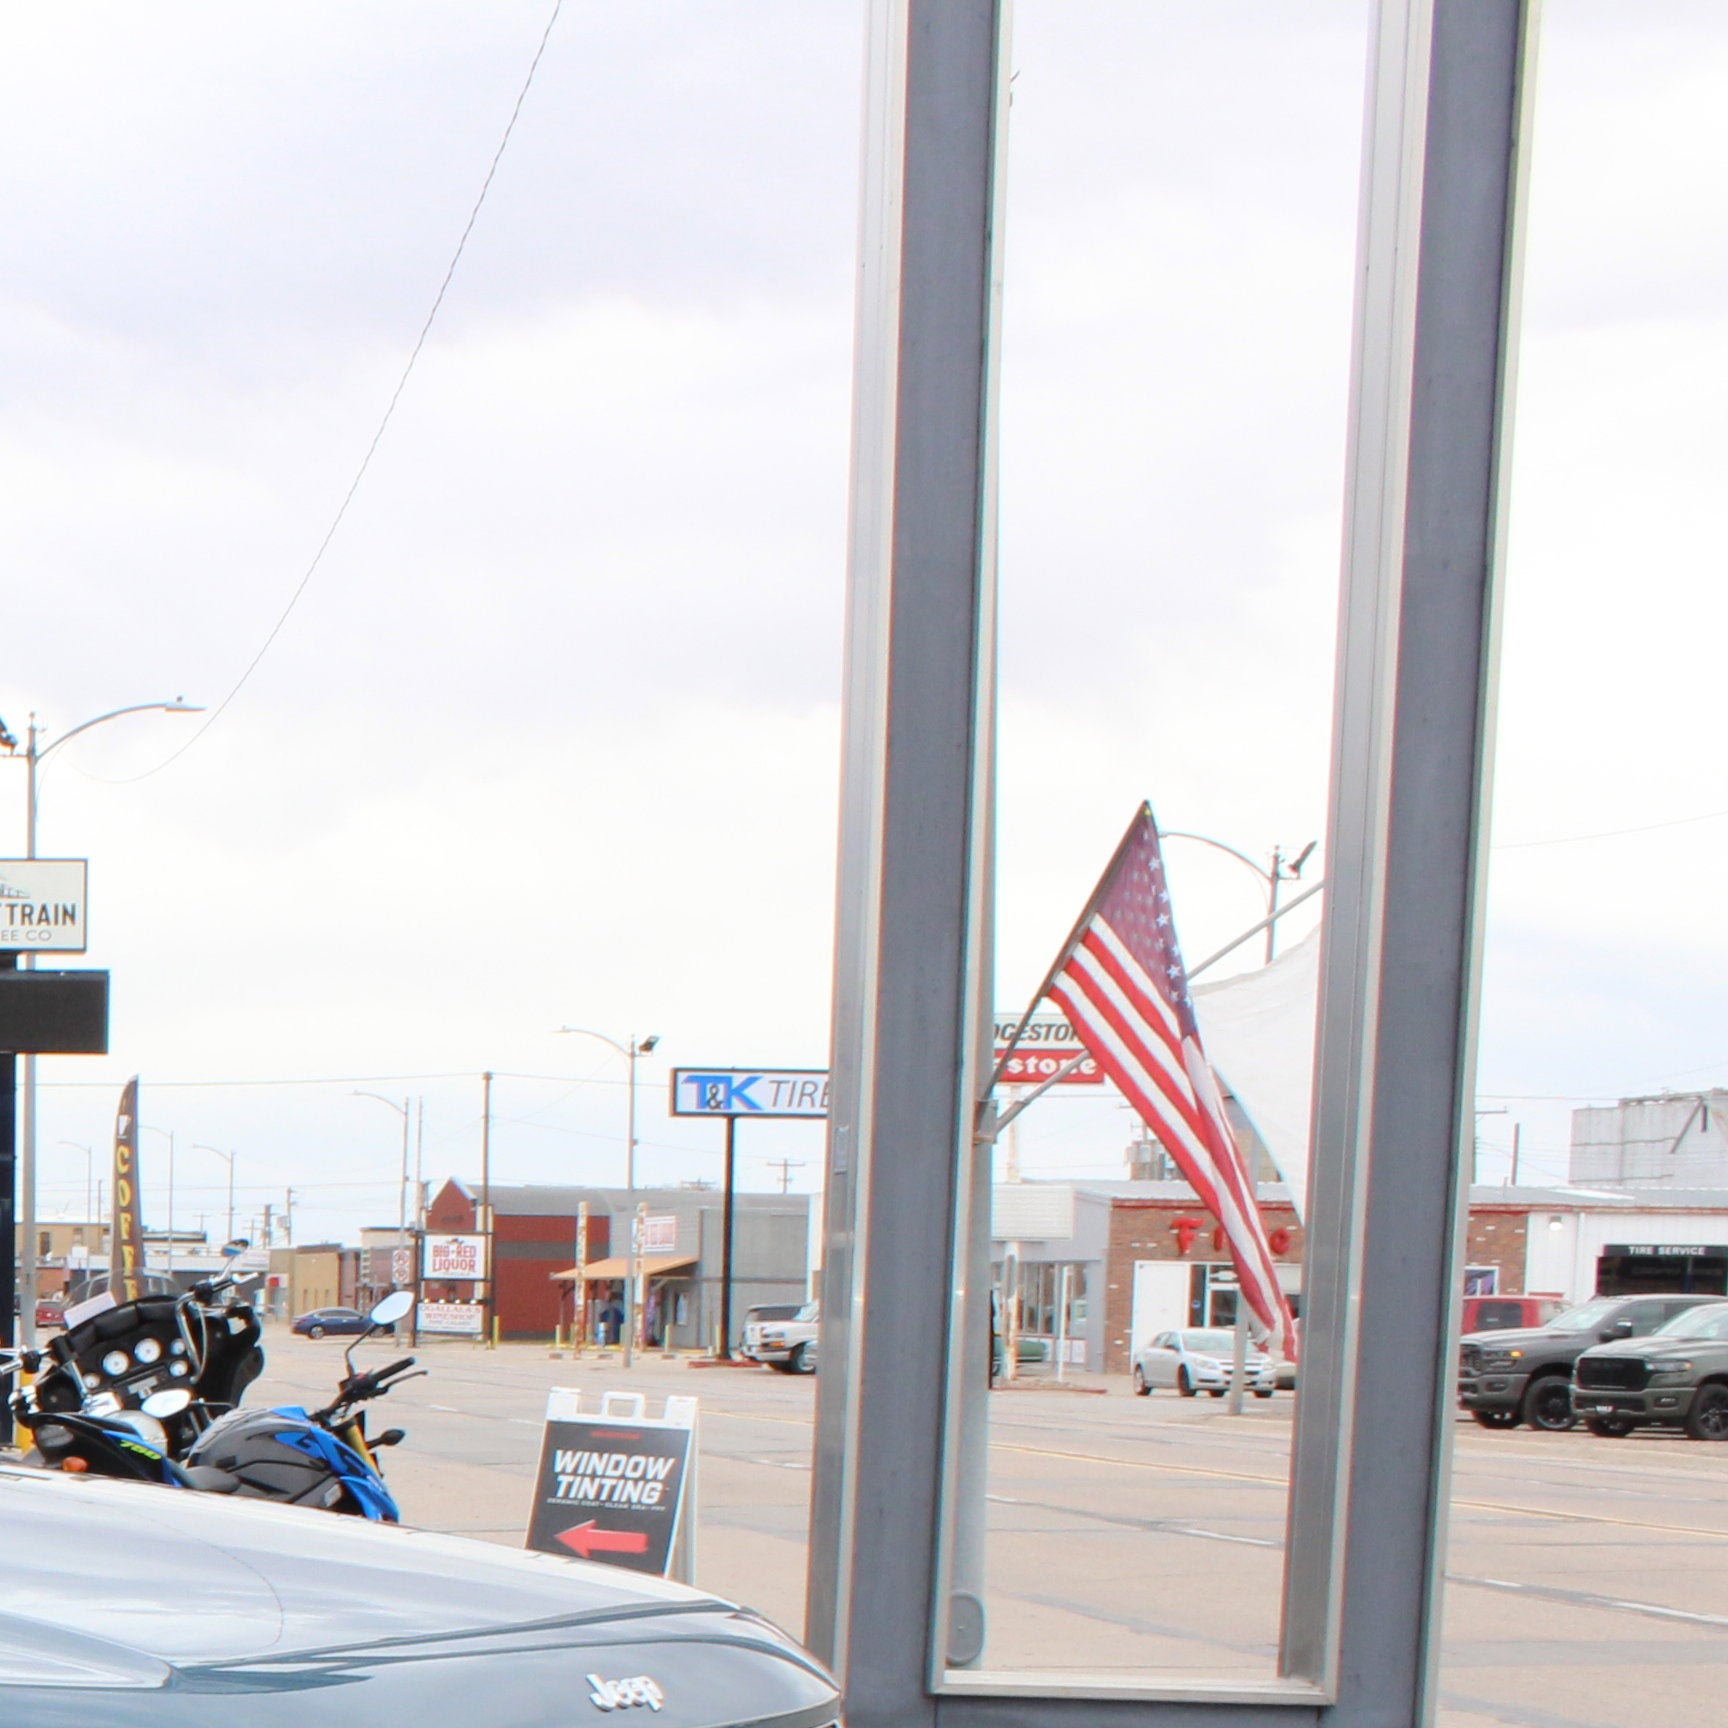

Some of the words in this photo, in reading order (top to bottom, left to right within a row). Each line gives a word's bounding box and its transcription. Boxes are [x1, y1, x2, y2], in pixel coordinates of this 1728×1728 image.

[1, 903, 76, 926] TRAIN
[25, 929, 52, 942] CO
[681, 1075, 765, 1111] T&K
[1628, 1245, 1653, 1256] TIRE
[1657, 1245, 1706, 1256] SERVICE
[432, 1259, 476, 1273] LIQUOR
[553, 1449, 676, 1480] WINDOW
[555, 1475, 664, 1505] TINTING
[586, 1674, 664, 1712] Jeep
